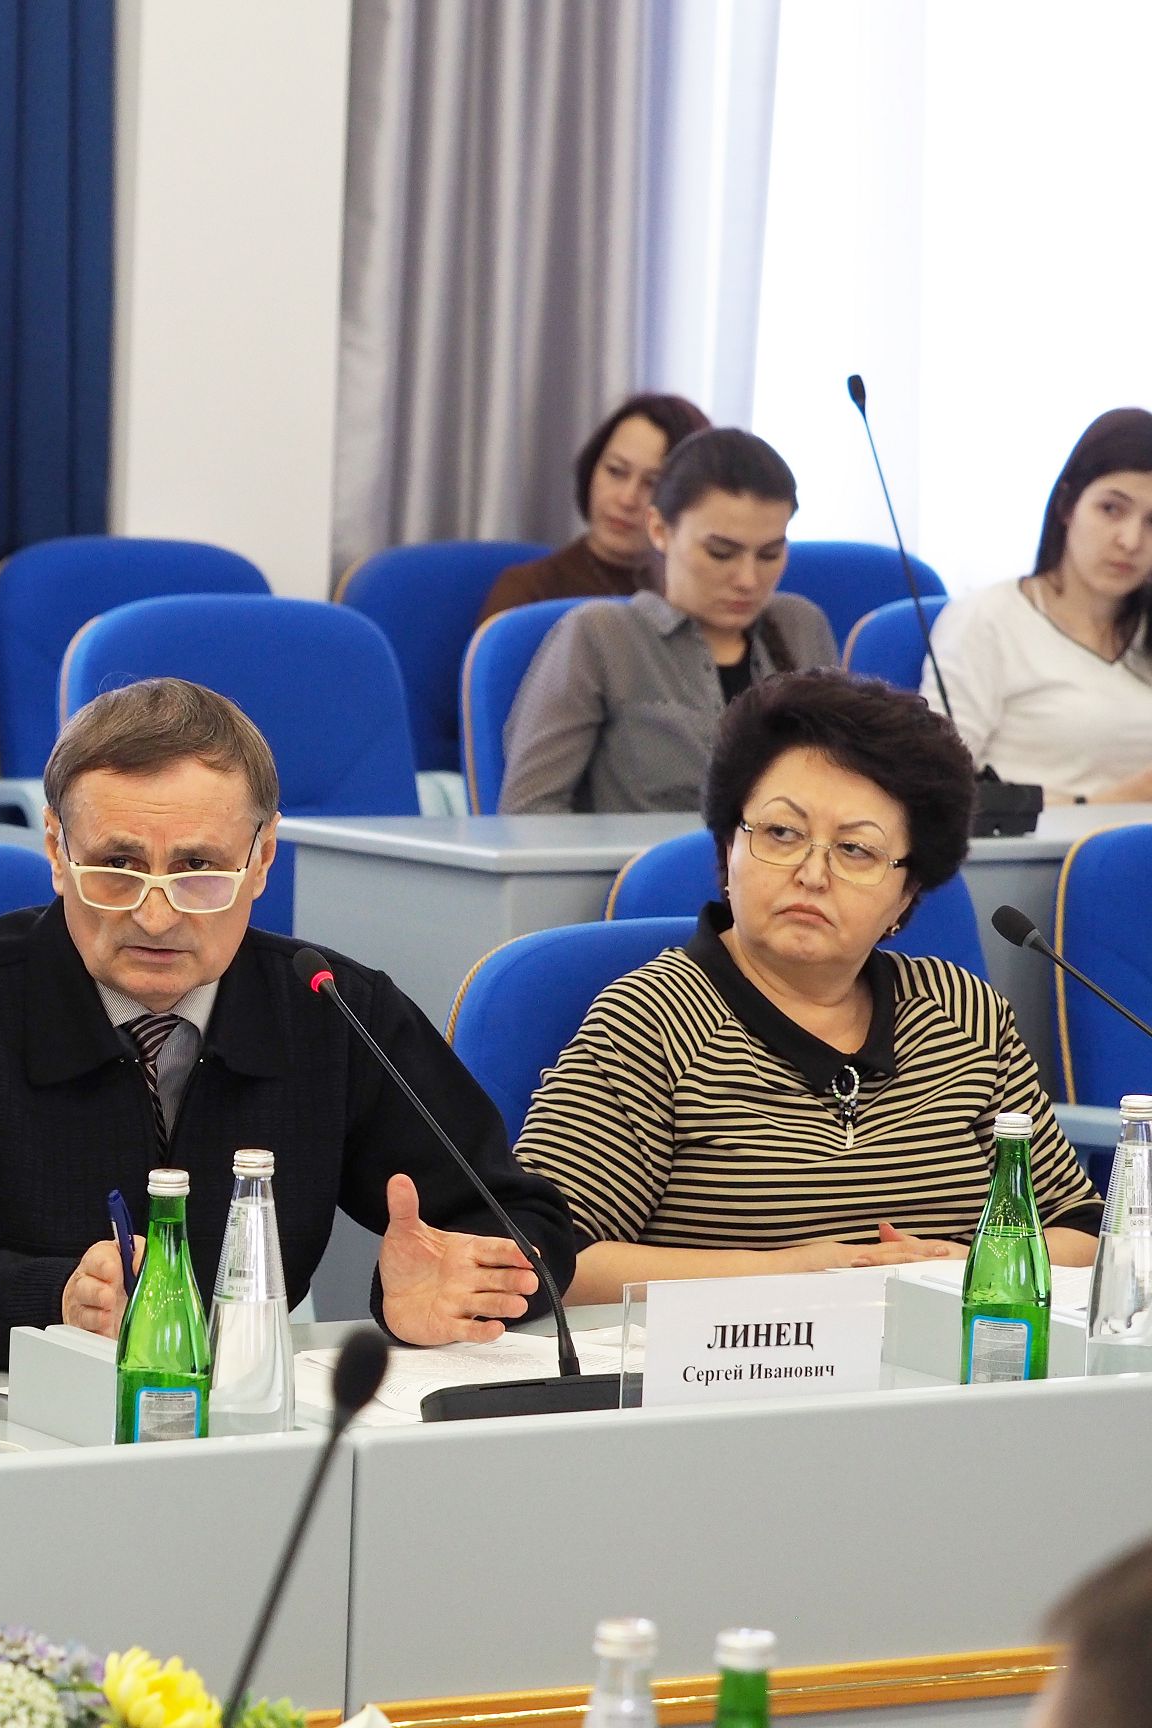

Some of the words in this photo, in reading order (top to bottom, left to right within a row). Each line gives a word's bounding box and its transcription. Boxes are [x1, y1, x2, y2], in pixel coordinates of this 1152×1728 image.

[706, 1321, 814, 1350] ЛИНЕЦ
[682, 1364, 743, 1387] Сергей
[749, 1363, 835, 1381] Иванович
